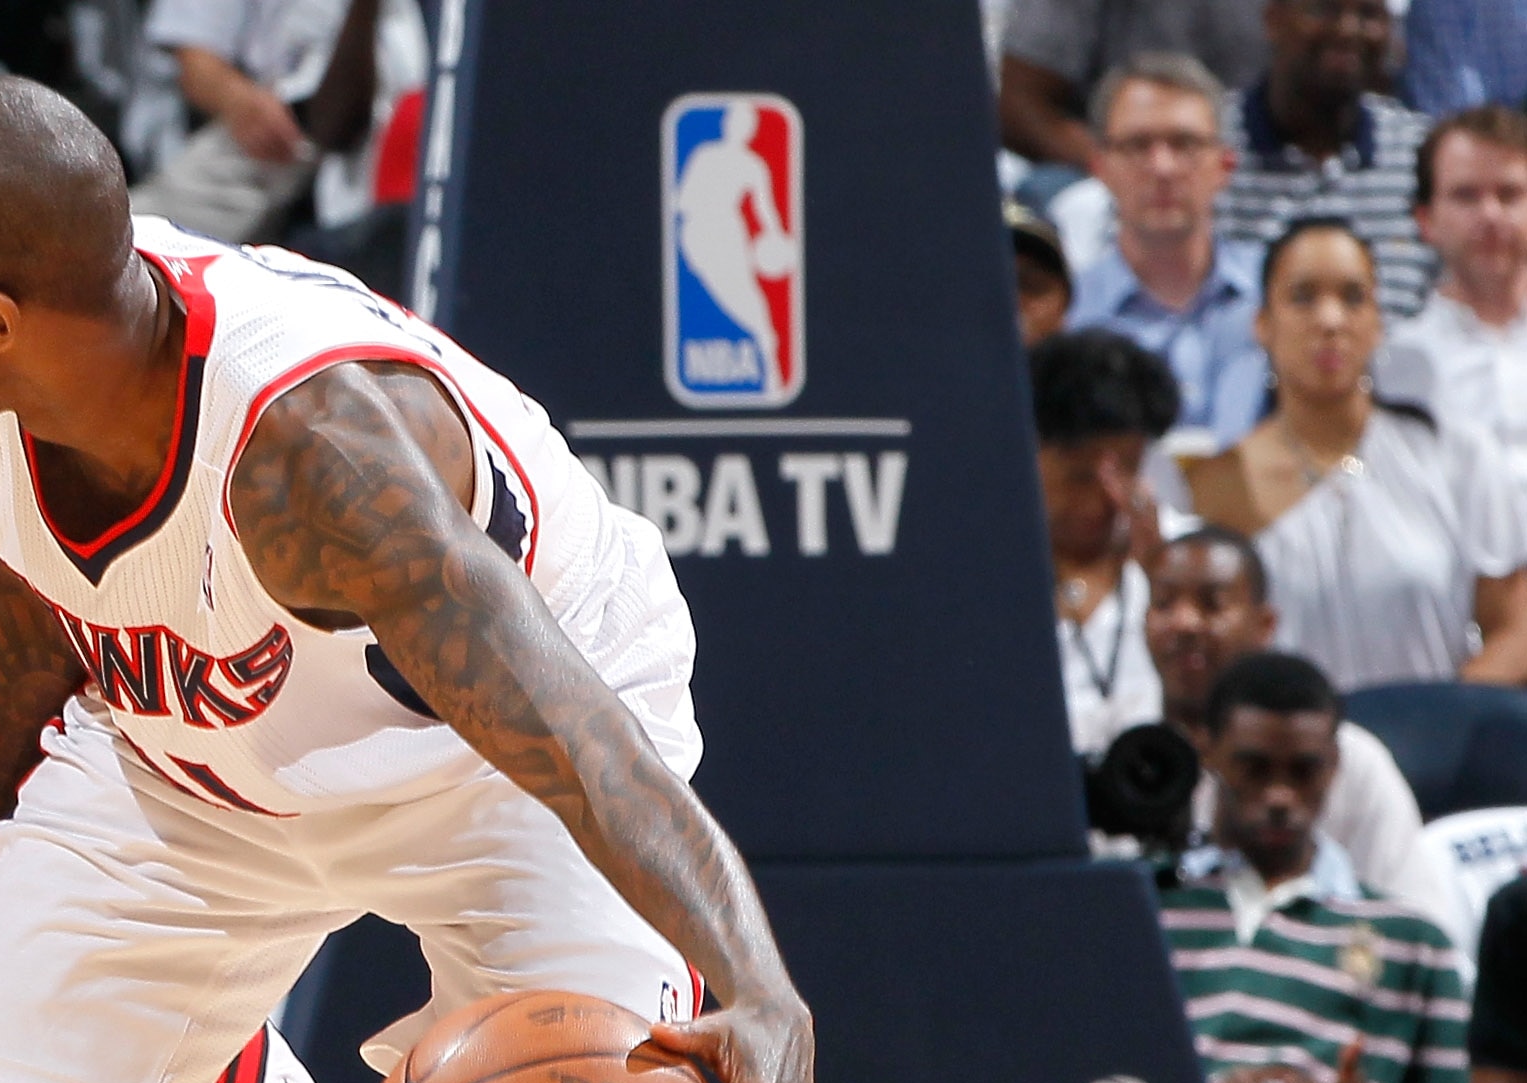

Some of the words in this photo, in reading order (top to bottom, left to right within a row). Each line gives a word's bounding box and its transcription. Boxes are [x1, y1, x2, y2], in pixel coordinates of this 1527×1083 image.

[685, 337, 762, 382] NBA
[580, 451, 772, 558] NBA
[778, 451, 908, 558] TV
